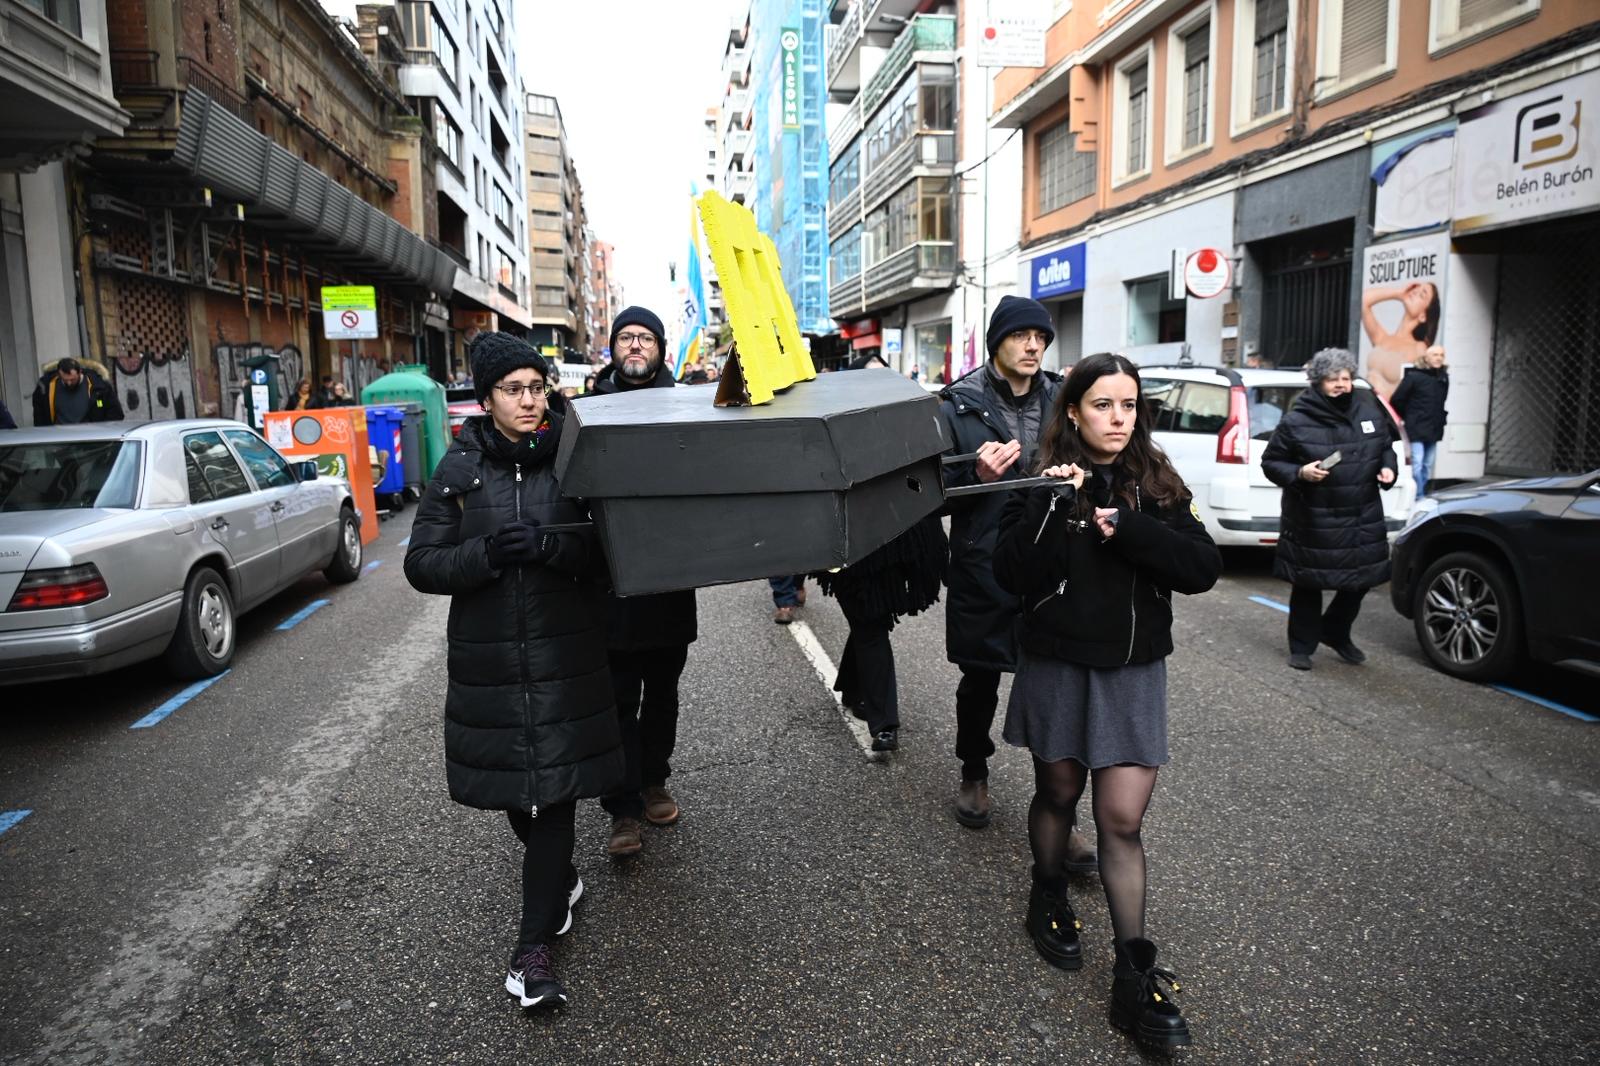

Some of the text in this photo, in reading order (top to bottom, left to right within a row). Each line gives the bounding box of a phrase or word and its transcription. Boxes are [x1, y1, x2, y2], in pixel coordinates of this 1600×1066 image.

[1496, 165, 1593, 200] Belén Burón
[1369, 254, 1437, 284] SCULPTURE
[255, 369, 266, 384] P
